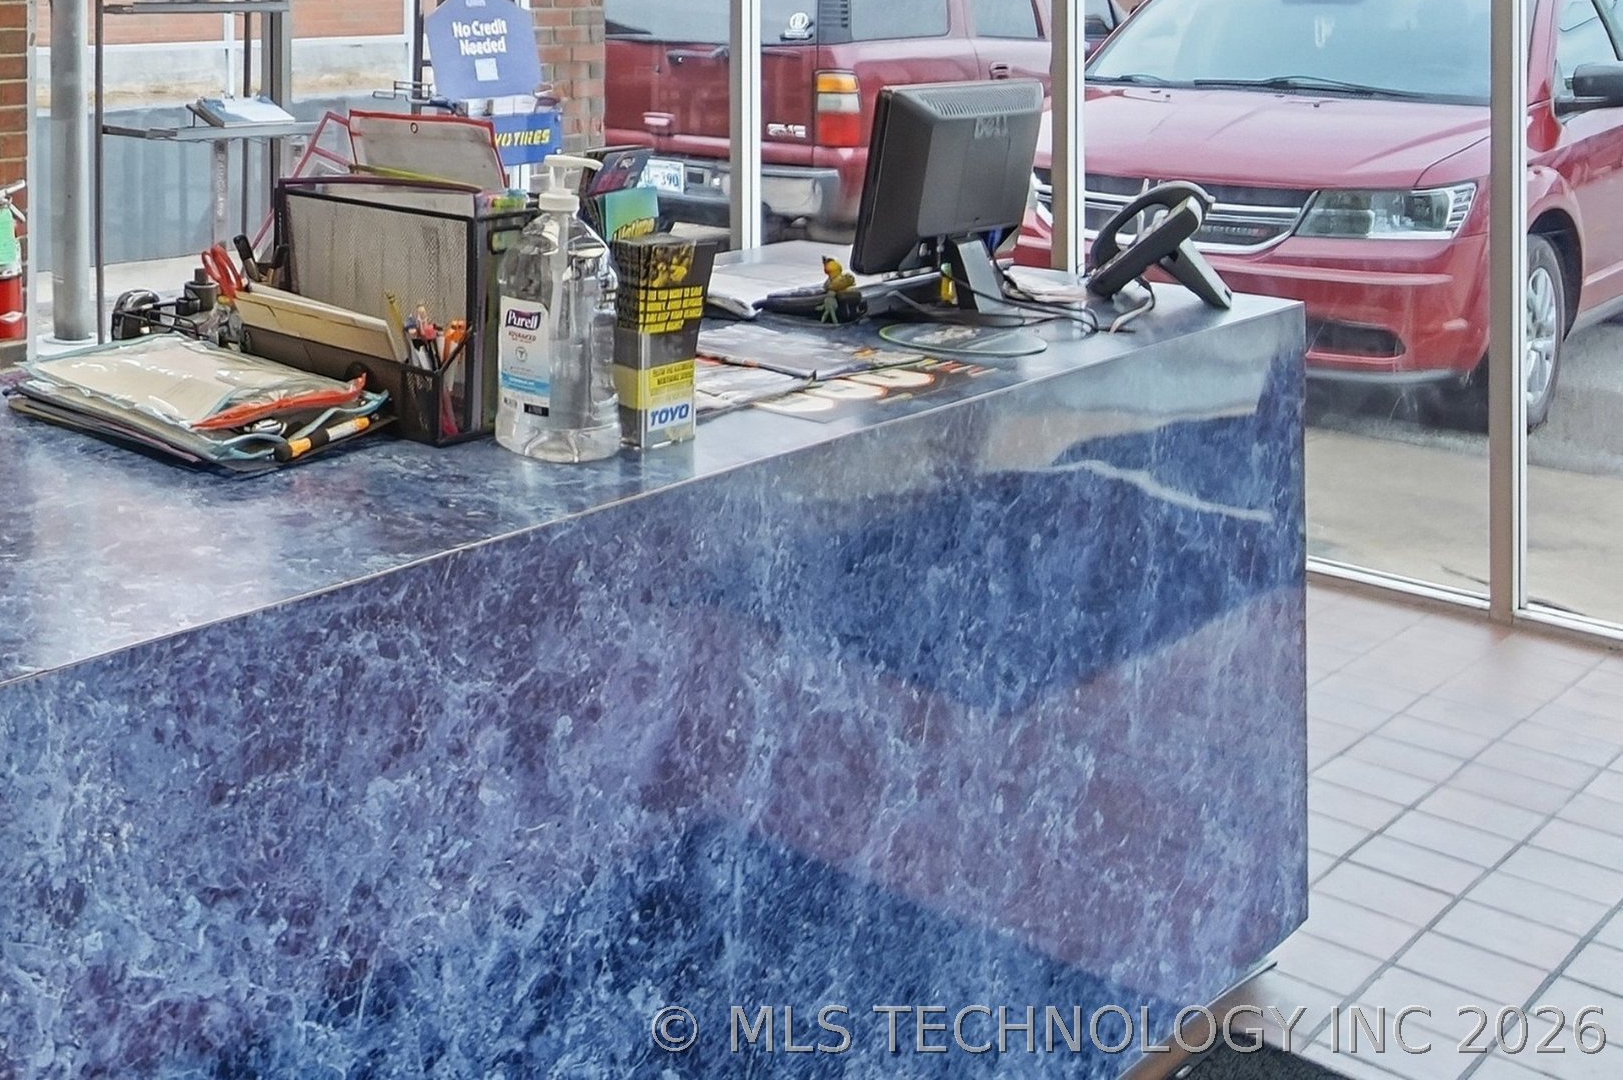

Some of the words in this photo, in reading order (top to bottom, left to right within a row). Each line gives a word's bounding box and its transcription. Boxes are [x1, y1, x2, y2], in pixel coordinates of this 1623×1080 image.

[452, 21, 471, 38] No
[472, 18, 508, 37] Credit
[459, 36, 507, 56] Needed
[650, 404, 690, 427] TOYO
